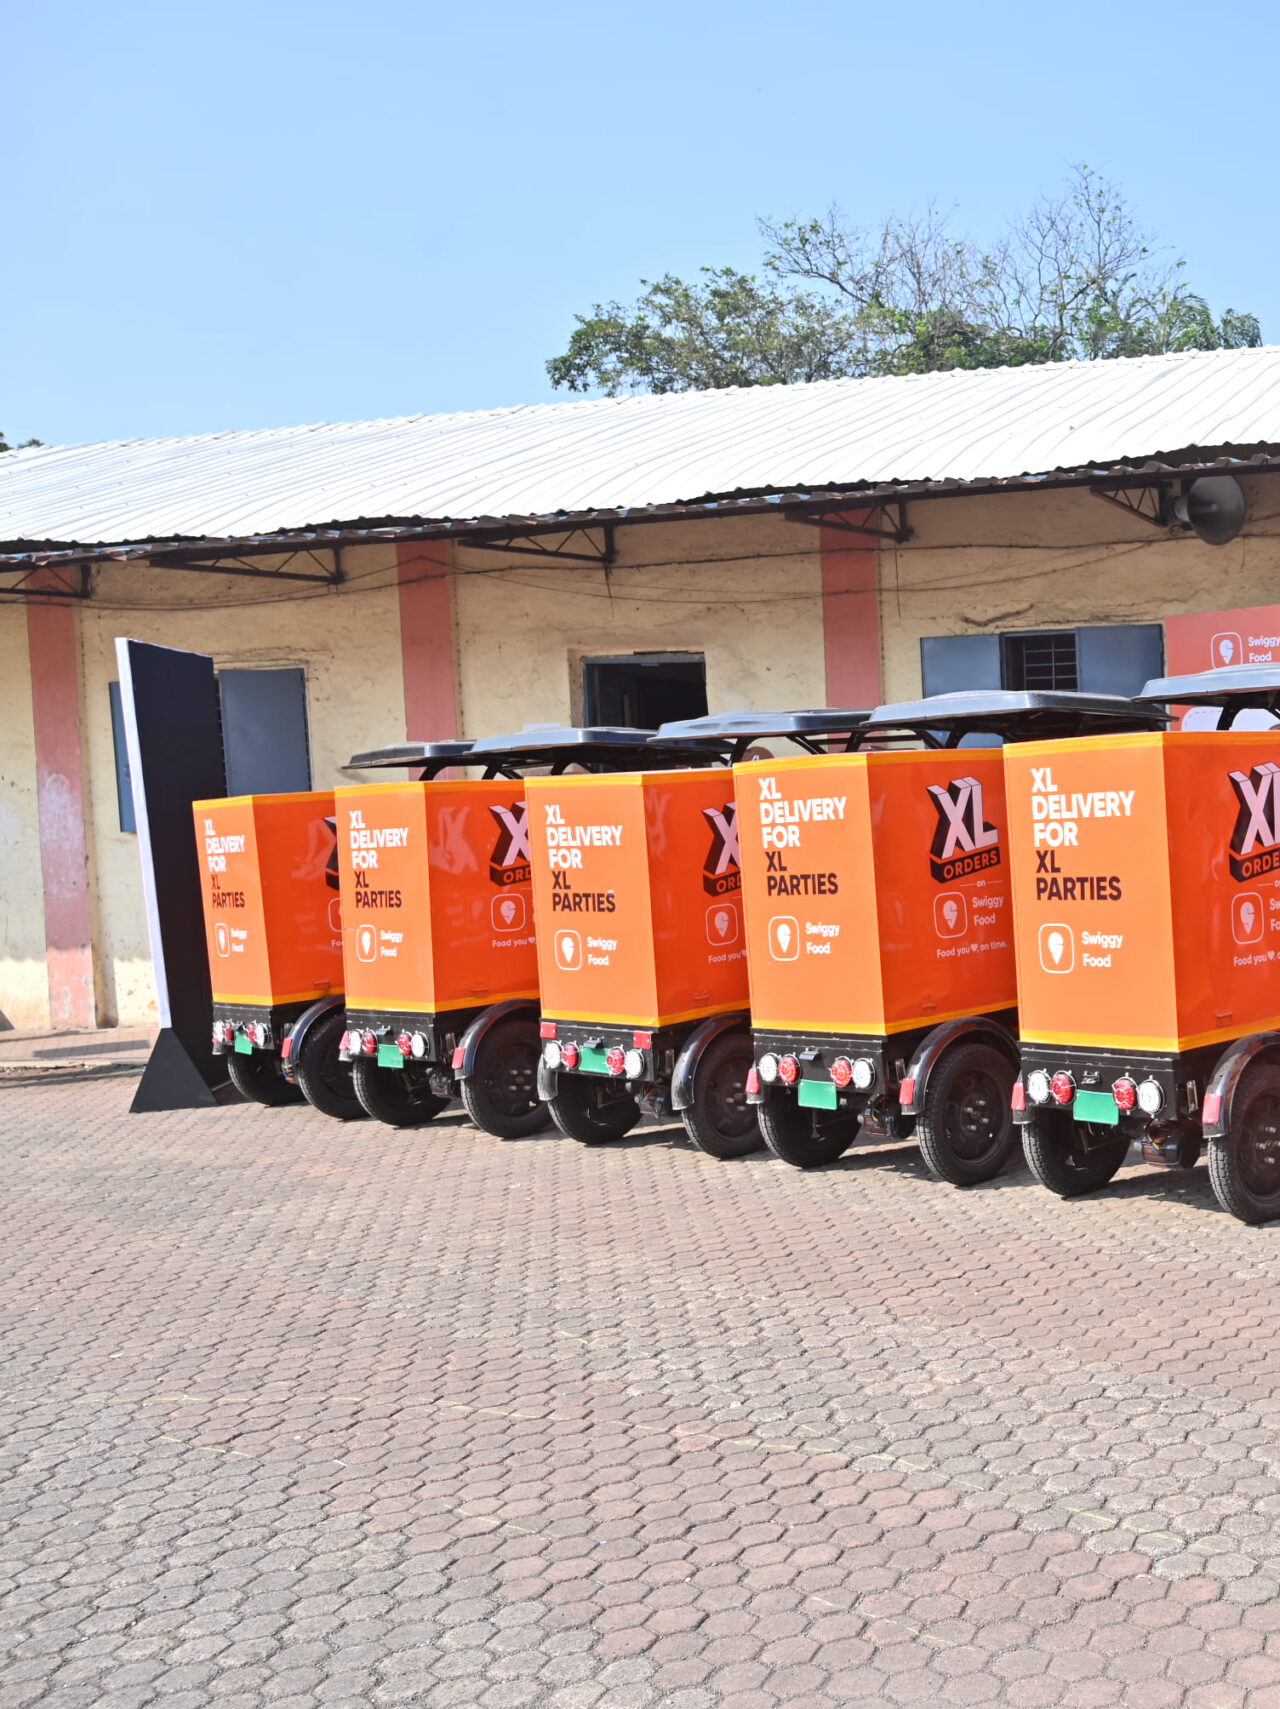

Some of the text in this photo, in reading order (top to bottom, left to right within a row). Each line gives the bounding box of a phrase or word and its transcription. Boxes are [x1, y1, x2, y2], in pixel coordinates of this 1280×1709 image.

[1248, 634, 1280, 648] Swiggy
[1248, 651, 1272, 662] Food
[759, 778, 781, 800] XL
[1031, 768, 1057, 792] XL
[760, 797, 846, 824] DELIVERY
[1031, 790, 1135, 820] DELIVERY
[349, 811, 365, 829] XL
[545, 805, 564, 824] XL
[926, 776, 999, 860] XL
[204, 819, 215, 836] XL
[488, 802, 530, 867] X
[546, 826, 622, 846] DELIVERY
[1034, 822, 1078, 847] FOR
[205, 835, 245, 854] DELIVERY
[350, 828, 408, 848] DELIVERY
[702, 802, 740, 875] X
[762, 826, 800, 848] FOR
[208, 856, 226, 872] FOR
[352, 851, 378, 869] FOR
[548, 849, 582, 868] FOR
[766, 851, 787, 872] XL
[944, 850, 998, 879] ORDERS
[1036, 850, 1061, 873] XL
[211, 874, 220, 889] XL
[354, 872, 369, 888] XL
[552, 871, 571, 889] XL
[767, 873, 838, 896] PARTIES
[1037, 876, 1122, 901] PARTIES
[212, 892, 245, 908] PARTIES
[356, 890, 402, 908] PARTIES
[552, 893, 616, 912] PARTIES
[972, 896, 1004, 910] Swiggy
[806, 922, 840, 936] Swiggy
[974, 914, 996, 926] Food
[332, 940, 342, 948] Fo
[380, 930, 403, 943] Swiggy
[492, 939, 527, 948] Food you
[587, 936, 617, 950] Swiggy
[1082, 931, 1123, 948] Swiggy
[381, 947, 396, 956] Food
[806, 942, 831, 954] Food
[937, 947, 955, 959] Food
[957, 946, 970, 956] you
[990, 940, 1008, 950] time.
[588, 954, 609, 966] Food
[708, 952, 740, 964] Food you
[1083, 954, 1110, 967] Food
[1233, 954, 1252, 966] Food
[1254, 952, 1267, 964] you
